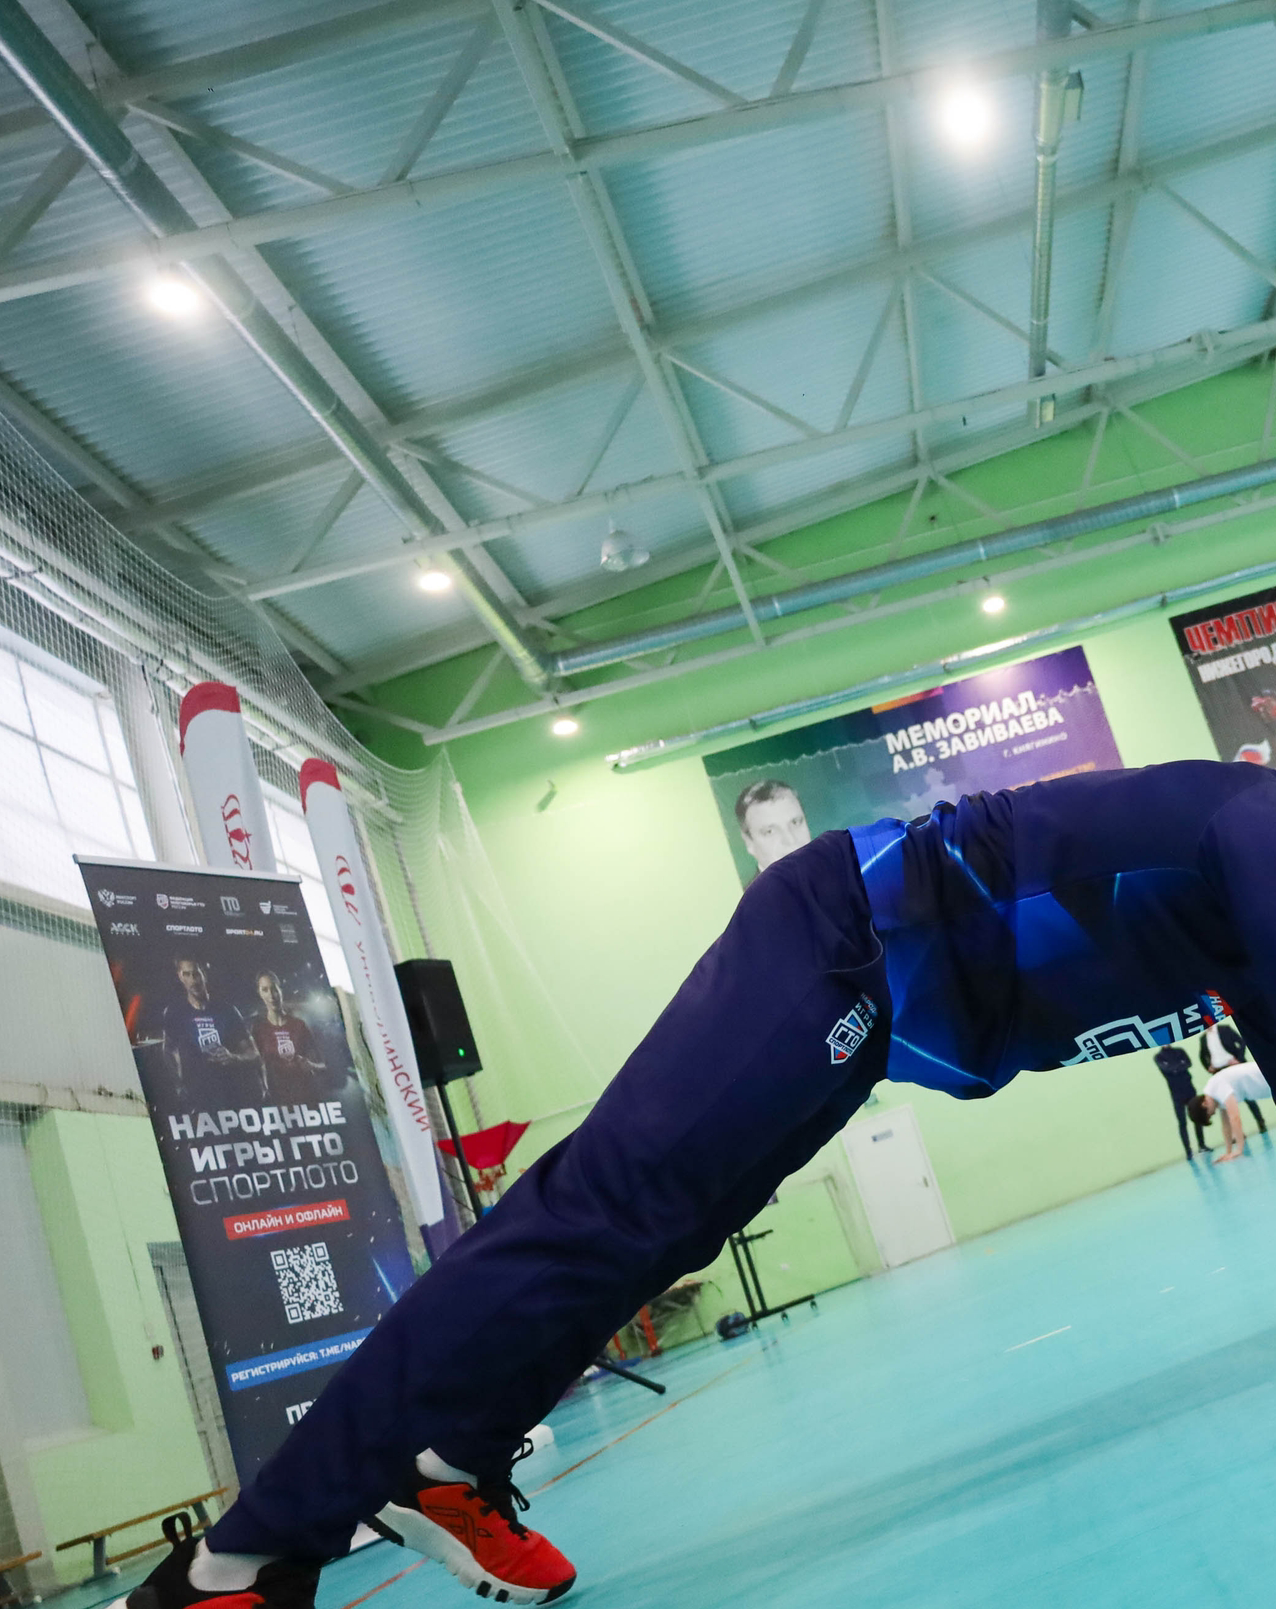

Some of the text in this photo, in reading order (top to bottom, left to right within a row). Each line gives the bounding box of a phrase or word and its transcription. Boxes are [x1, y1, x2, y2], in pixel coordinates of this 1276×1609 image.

[885, 690, 1037, 754] МЕМОРИАЛ
[893, 707, 1064, 773] А.В. ЗАВИВАЕВА
[835, 1025, 860, 1048] ГТО
[168, 1101, 346, 1140] НАРОДНЫЕ
[190, 1132, 344, 1173] ИГРЫ ГТО
[190, 1160, 359, 1205] СПОРТЛОТО
[234, 1205, 344, 1233] ОНЛАЙН И ОФЛАЙН
[231, 1352, 319, 1383] РЕГИСТРИРУЙСЯ:
